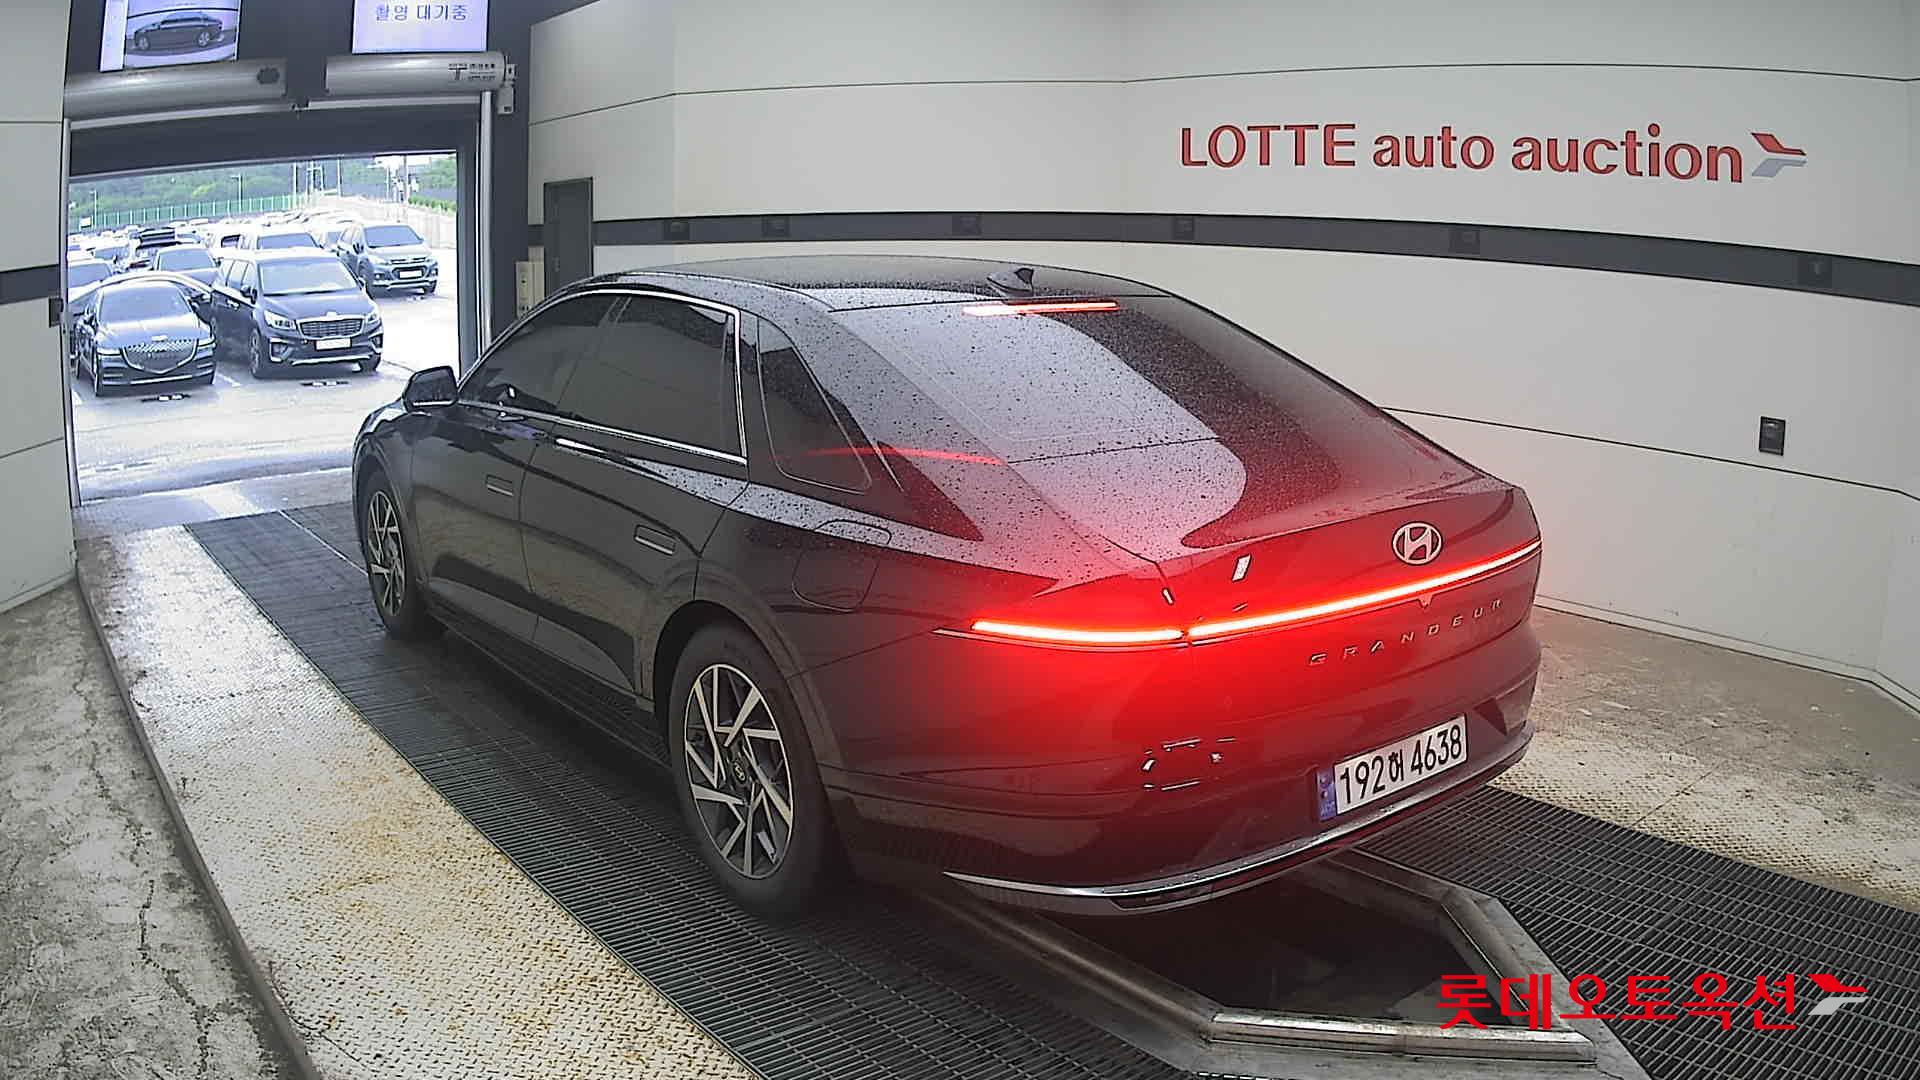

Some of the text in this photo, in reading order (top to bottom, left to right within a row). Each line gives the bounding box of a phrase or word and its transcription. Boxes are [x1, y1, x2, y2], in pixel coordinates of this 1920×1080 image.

[417, 4, 467, 21] 대기중
[1181, 122, 1743, 183] LOTTE auto auction
[1309, 598, 1503, 667] GRANDEUR
[1340, 724, 1462, 804] 192허 4638
